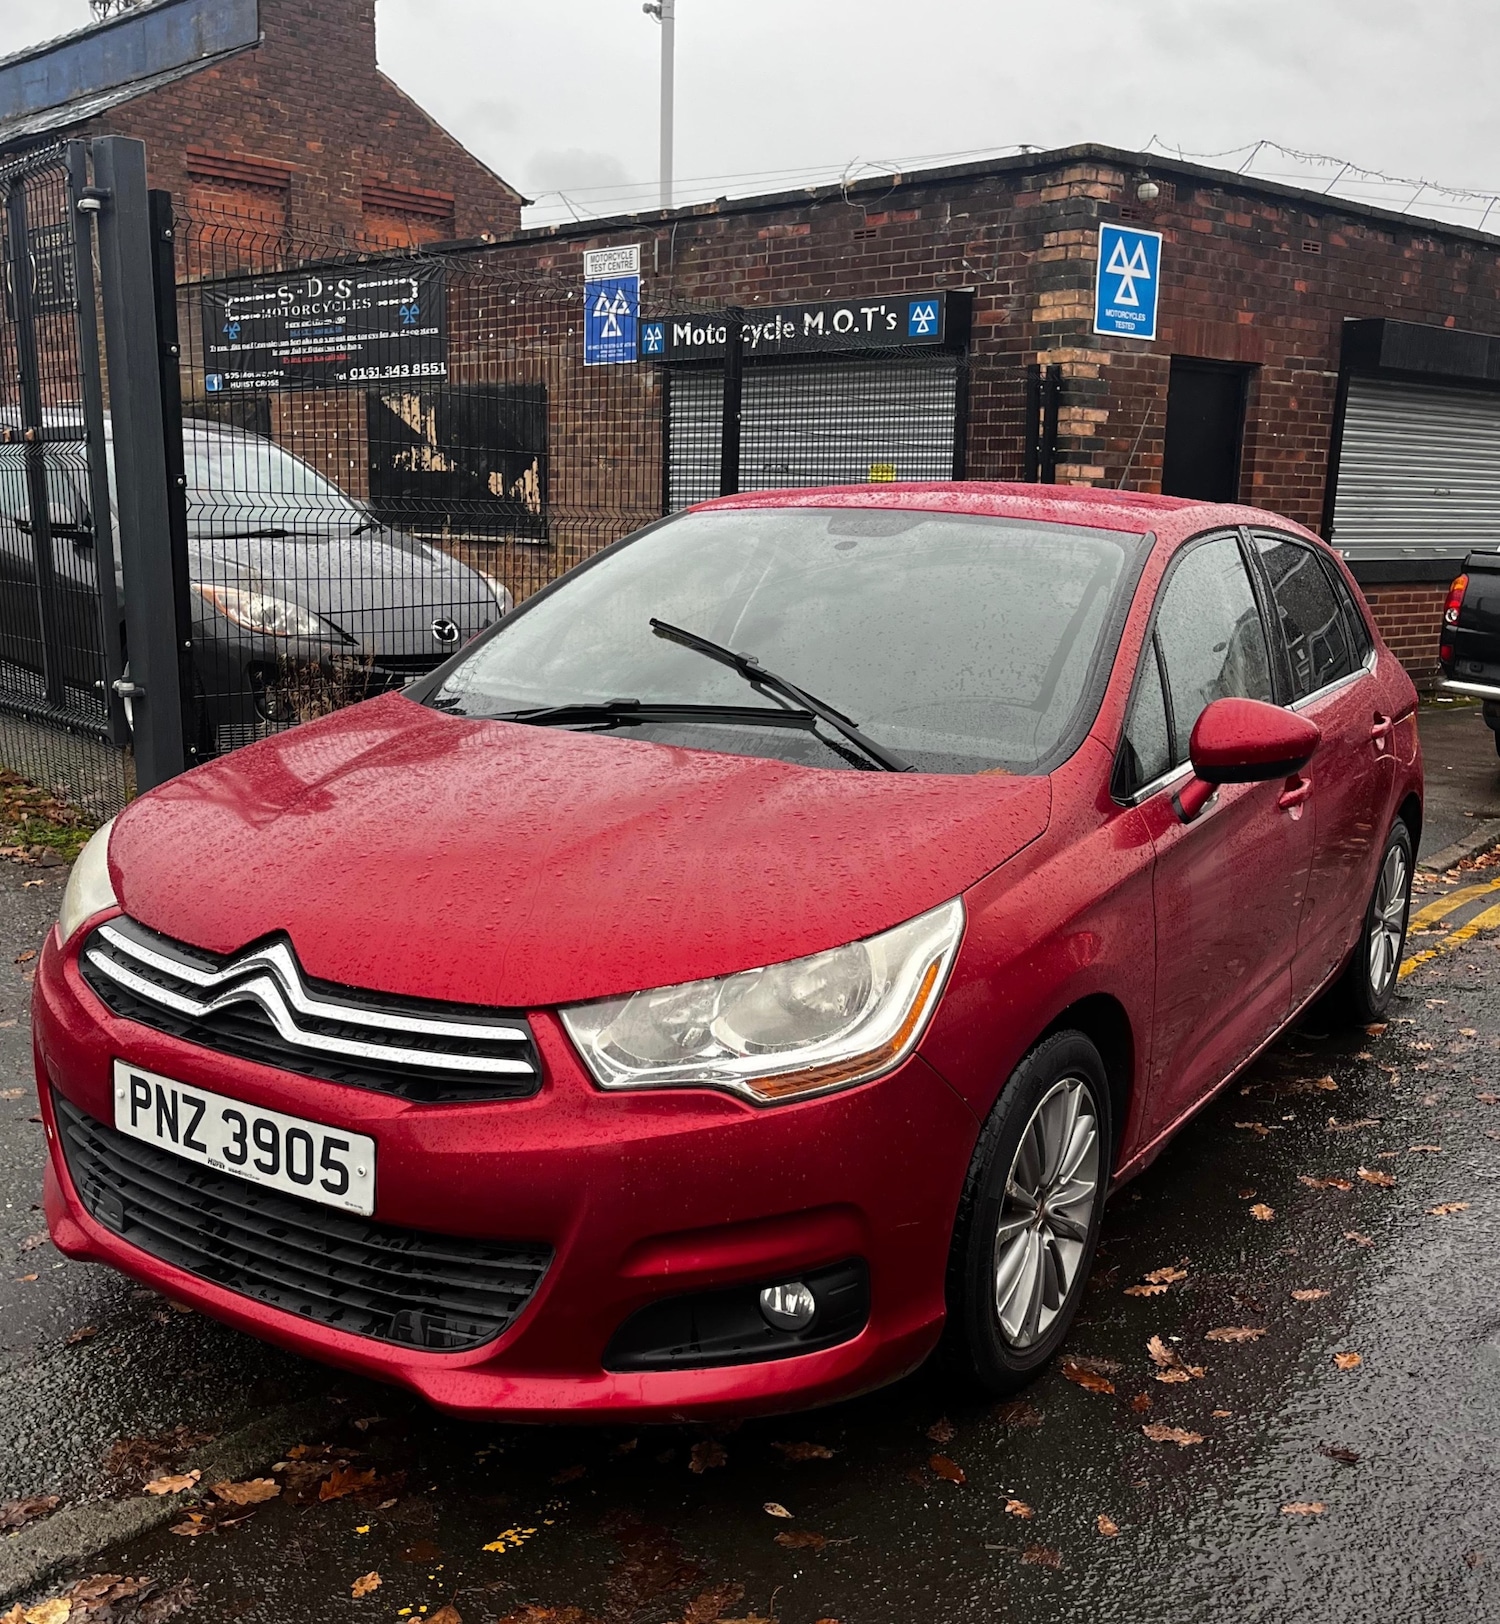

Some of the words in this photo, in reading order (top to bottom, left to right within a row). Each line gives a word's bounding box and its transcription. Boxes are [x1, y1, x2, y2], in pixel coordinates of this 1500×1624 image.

[590, 250, 633, 263] MOTORCYCLE
[590, 263, 606, 273] TEST
[607, 260, 633, 271] CENTRE
[262, 298, 372, 319] MOTORCYCLES
[1105, 309, 1146, 321] MOTORCYCLES
[673, 314, 796, 348] Motocycle
[803, 305, 898, 336] M.O.T's
[1115, 320, 1135, 330] TESTED
[350, 367, 380, 380] 0161
[384, 364, 409, 377] 343
[414, 361, 446, 375] 8551
[130, 1074, 207, 1154] PNZ
[221, 1108, 350, 1195] 3905
